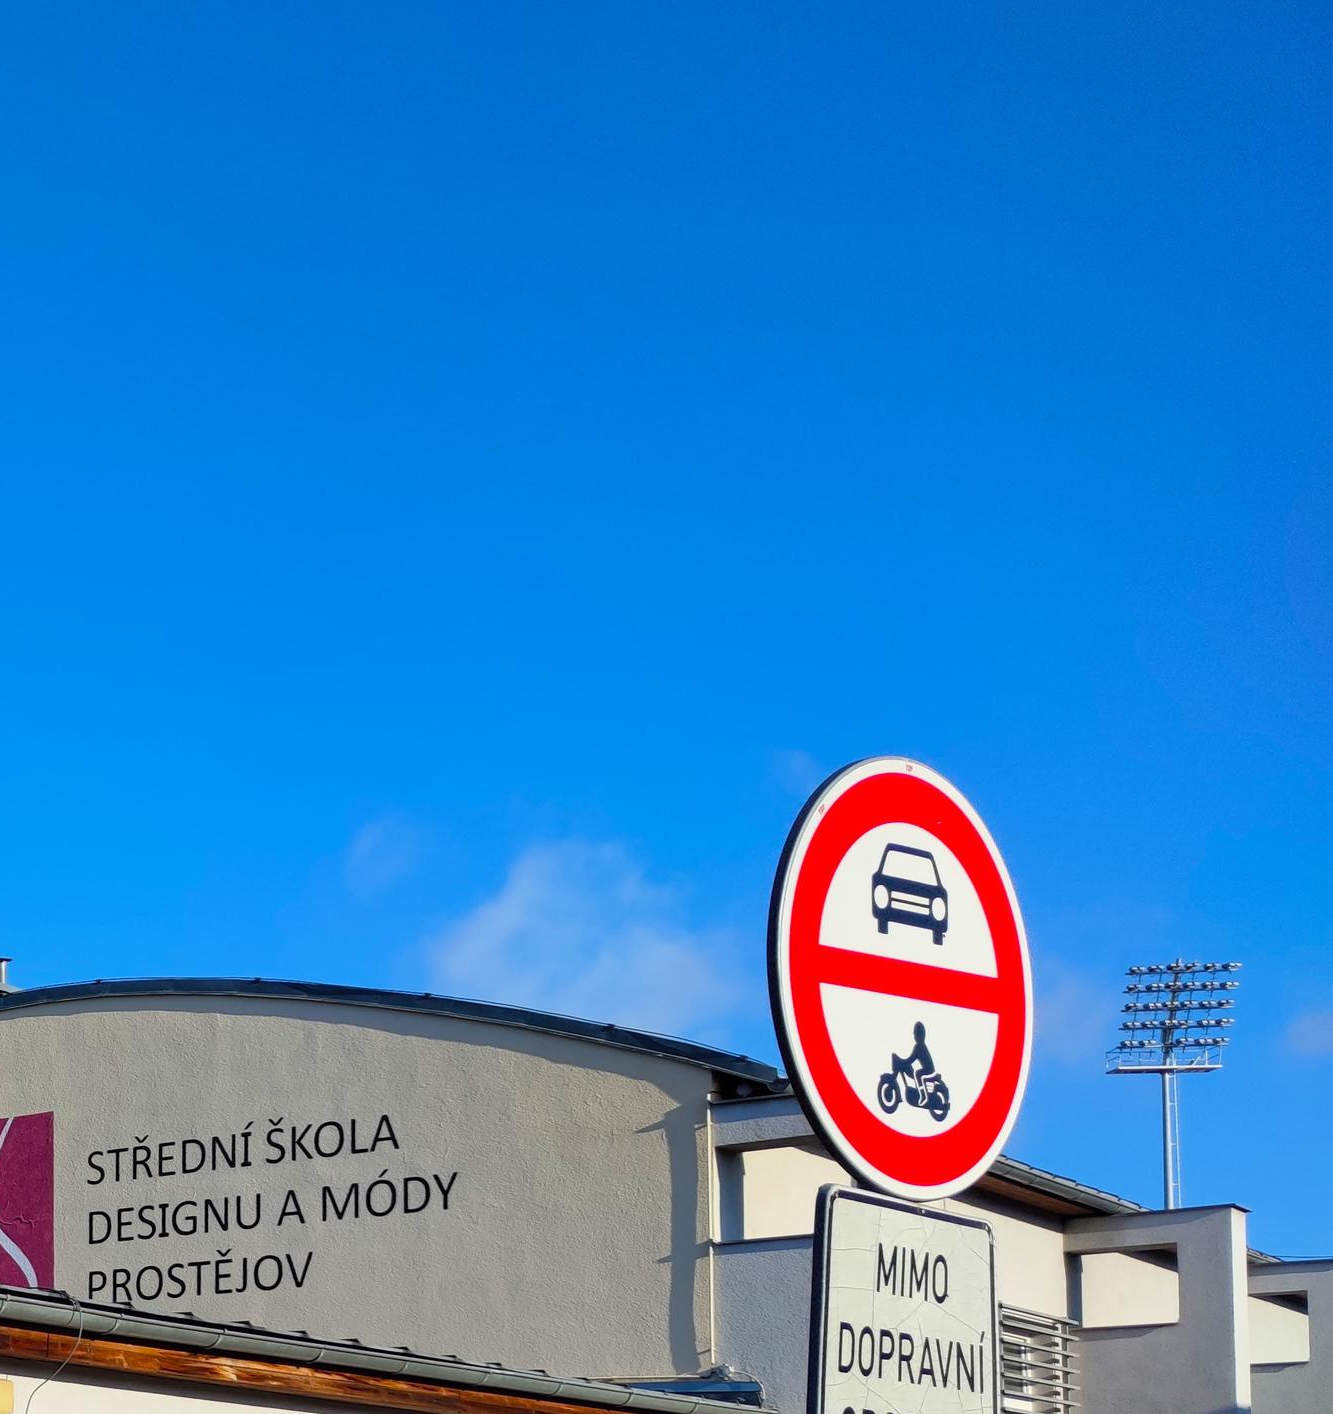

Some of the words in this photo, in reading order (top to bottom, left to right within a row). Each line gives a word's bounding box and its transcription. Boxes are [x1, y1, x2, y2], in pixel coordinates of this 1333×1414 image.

[86, 1121, 253, 1186] STŘEDNÍ
[265, 1114, 400, 1165] ŠKOLA
[87, 1193, 262, 1245] DESIGNU
[277, 1189, 306, 1227] A
[321, 1168, 458, 1222] MÓDY
[87, 1249, 314, 1302] PROSTĚJOV
[876, 1242, 949, 1304] MIMO
[837, 1321, 985, 1394] DOPRAVNÍ
